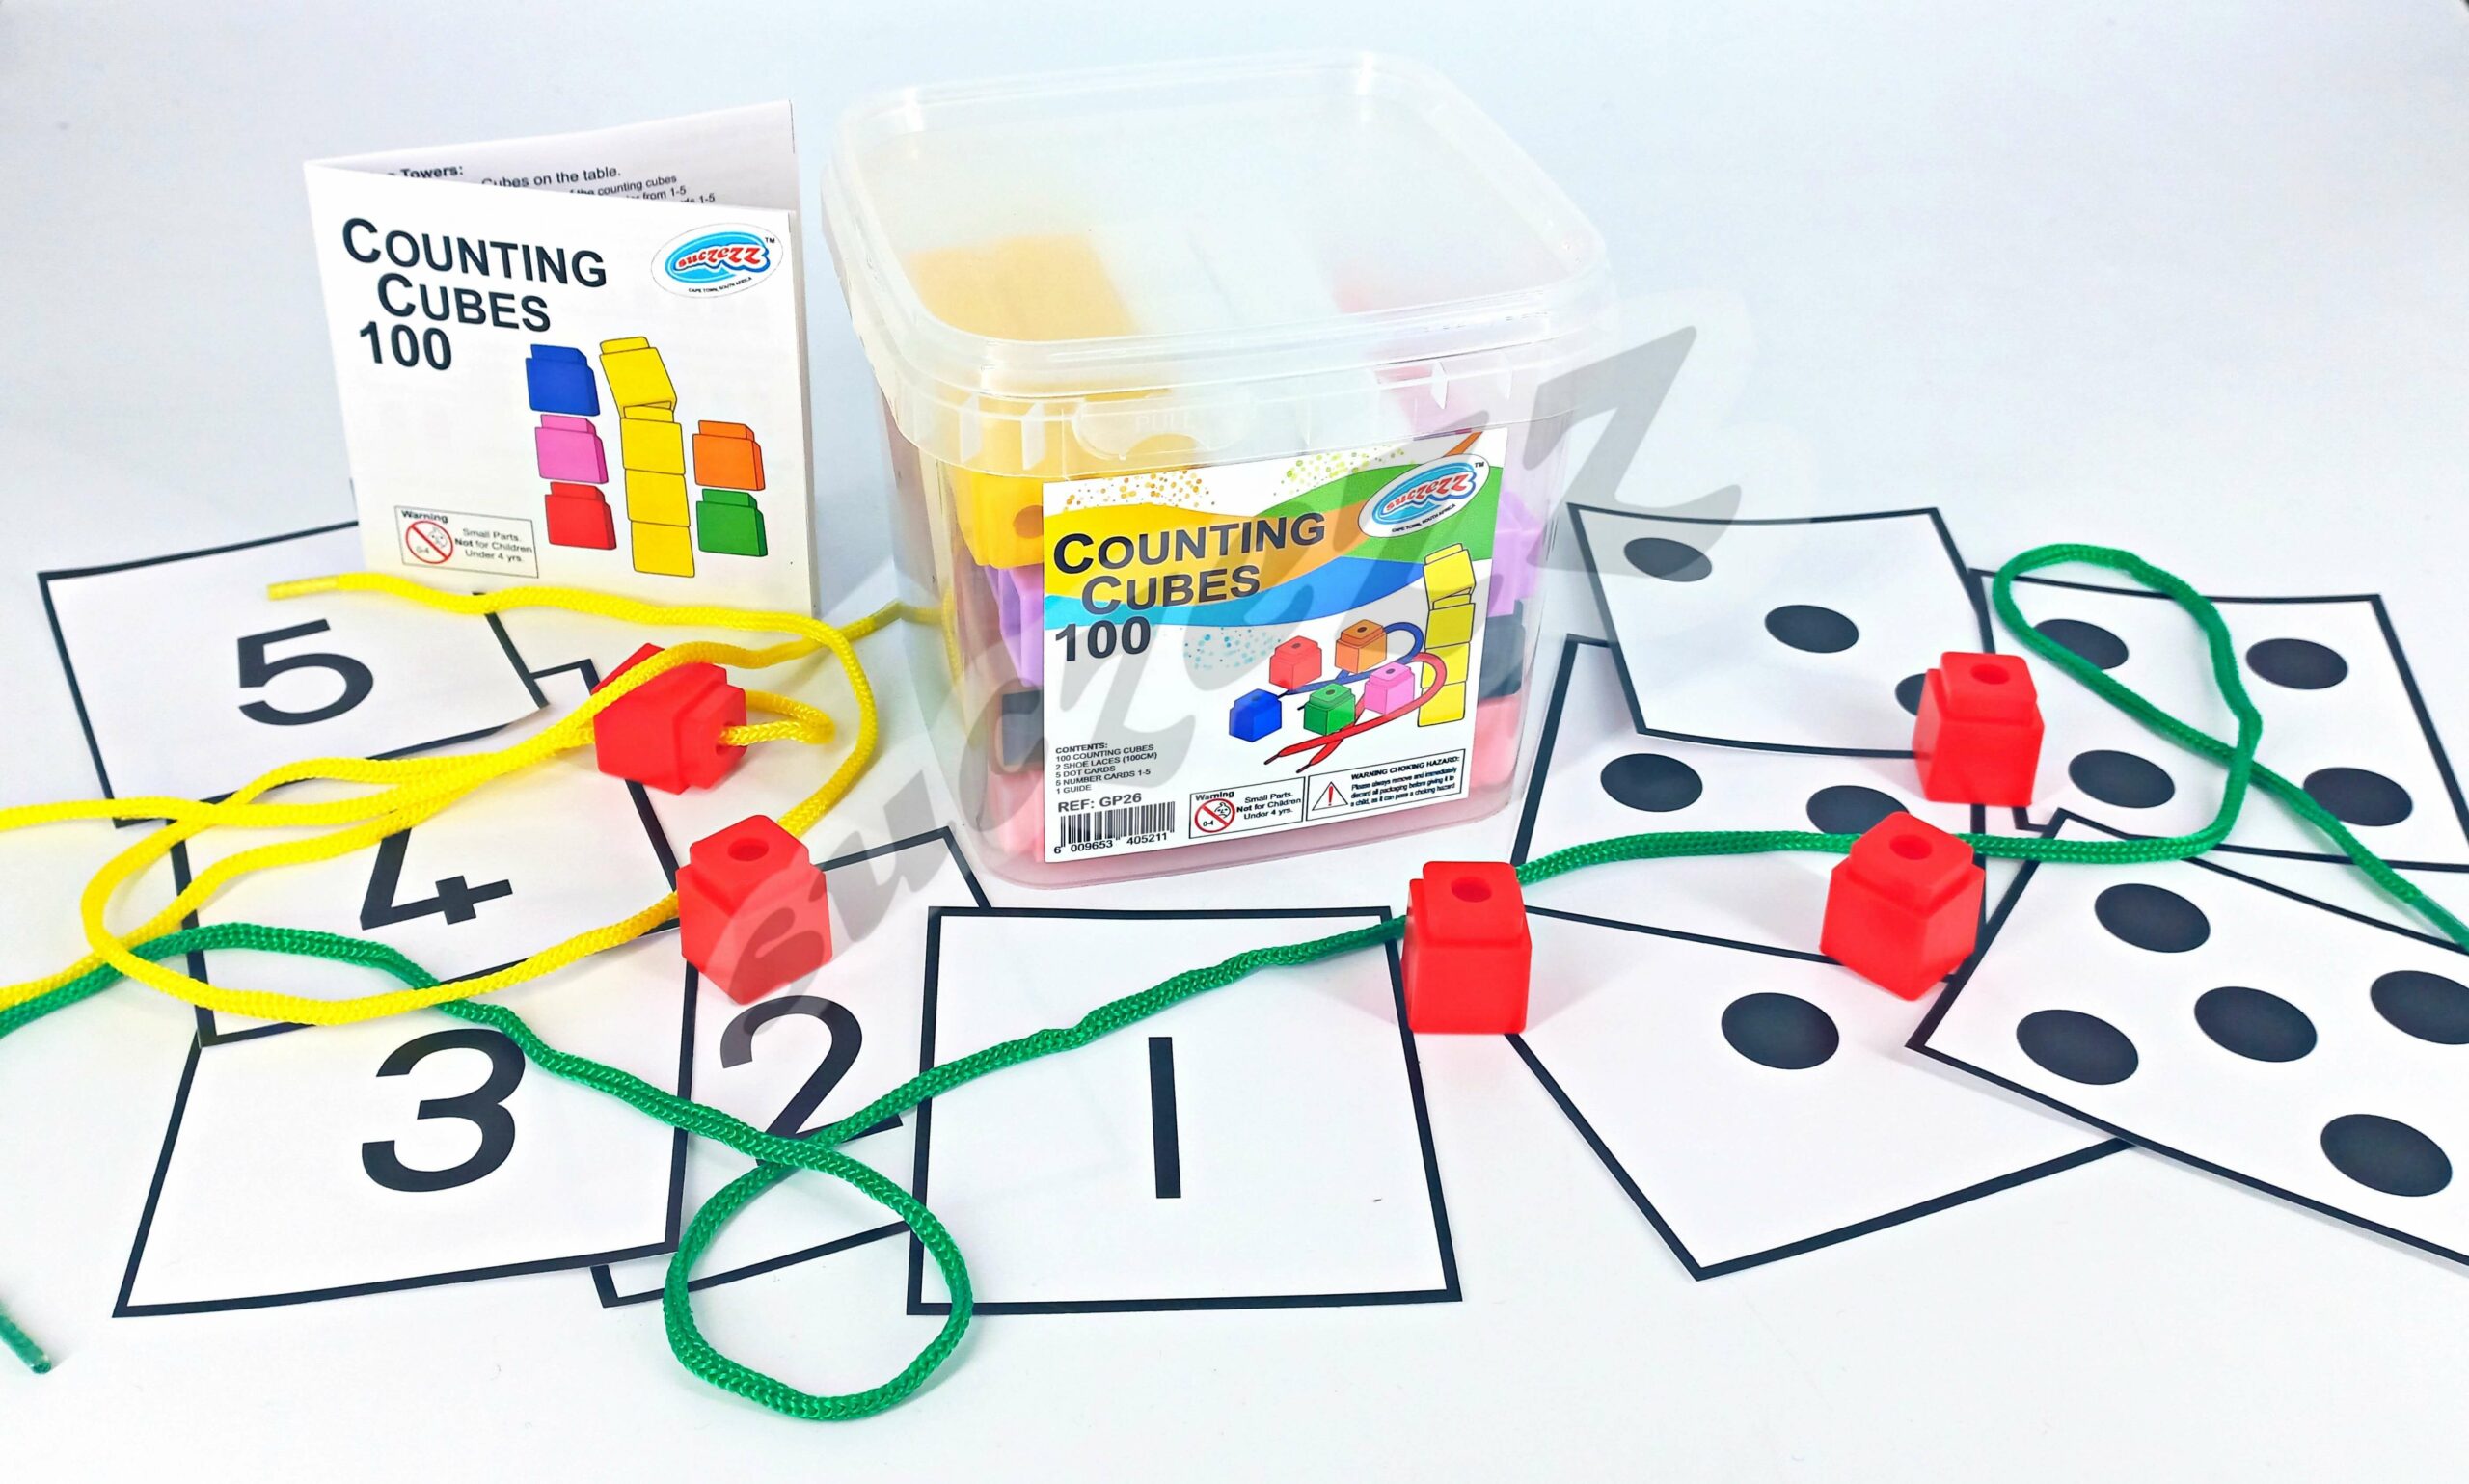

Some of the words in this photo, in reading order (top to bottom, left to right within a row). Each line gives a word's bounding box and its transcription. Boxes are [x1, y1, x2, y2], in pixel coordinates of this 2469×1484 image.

[400, 166, 463, 179] Towers:
[533, 175, 552, 186] on
[556, 172, 579, 183] the
[583, 166, 621, 181] table.
[598, 181, 642, 196] counting
[645, 175, 677, 187] cubes
[670, 185, 687, 197] 1-5
[699, 193, 716, 203] 1-5
[341, 217, 607, 288] COUNTING
[377, 273, 551, 333] CUBES
[359, 321, 452, 371] 100
[401, 509, 448, 524] Warning
[463, 528, 490, 538] Small
[454, 538, 474, 548] Not
[475, 539, 489, 549] for
[491, 541, 532, 553] Children
[1053, 512, 1326, 574] COUNTING
[465, 550, 495, 559] Under
[1082, 565, 1261, 616] CUBES
[1055, 615, 1152, 661] 100
[237, 620, 373, 726] 5
[1055, 742, 1108, 754] CONTENTS:
[1072, 748, 1121, 760] COUNTING
[1123, 744, 1154, 754] CUBES
[1063, 760, 1089, 769] SHOE
[1091, 756, 1121, 767] LACES
[1123, 752, 1157, 763] (100CM)
[1351, 769, 1388, 780] WARNING
[1390, 763, 1424, 773] CHOKING
[1426, 756, 1460, 767] HAZARD:
[1063, 775, 1102, 786] NUMBER
[1104, 770, 1135, 780] CARDS
[1138, 768, 1151, 776] 1-5
[1084, 765, 1116, 775] CARDS
[1424, 767, 1457, 778] immediately
[1063, 784, 1092, 794] GUIDE
[1195, 791, 1234, 801] Warning
[1350, 790, 1371, 798] discard
[1379, 784, 1408, 795] packaging
[1426, 777, 1444, 786] giving
[1414, 787, 1436, 796] choking
[1436, 782, 1455, 792] hazard
[1058, 799, 1095, 812] REF:
[1099, 793, 1142, 807] GP26
[1244, 796, 1268, 804] Small
[1267, 798, 1301, 808] Children
[1243, 811, 1268, 820] Under
[1053, 846, 1062, 854] 6
[1071, 840, 1113, 852] 009653
[1126, 832, 1167, 845] 405211
[359, 826, 513, 931] 4
[719, 995, 904, 1166] 2
[361, 1029, 527, 1194] 3
[1148, 1036, 1182, 1200] 1
